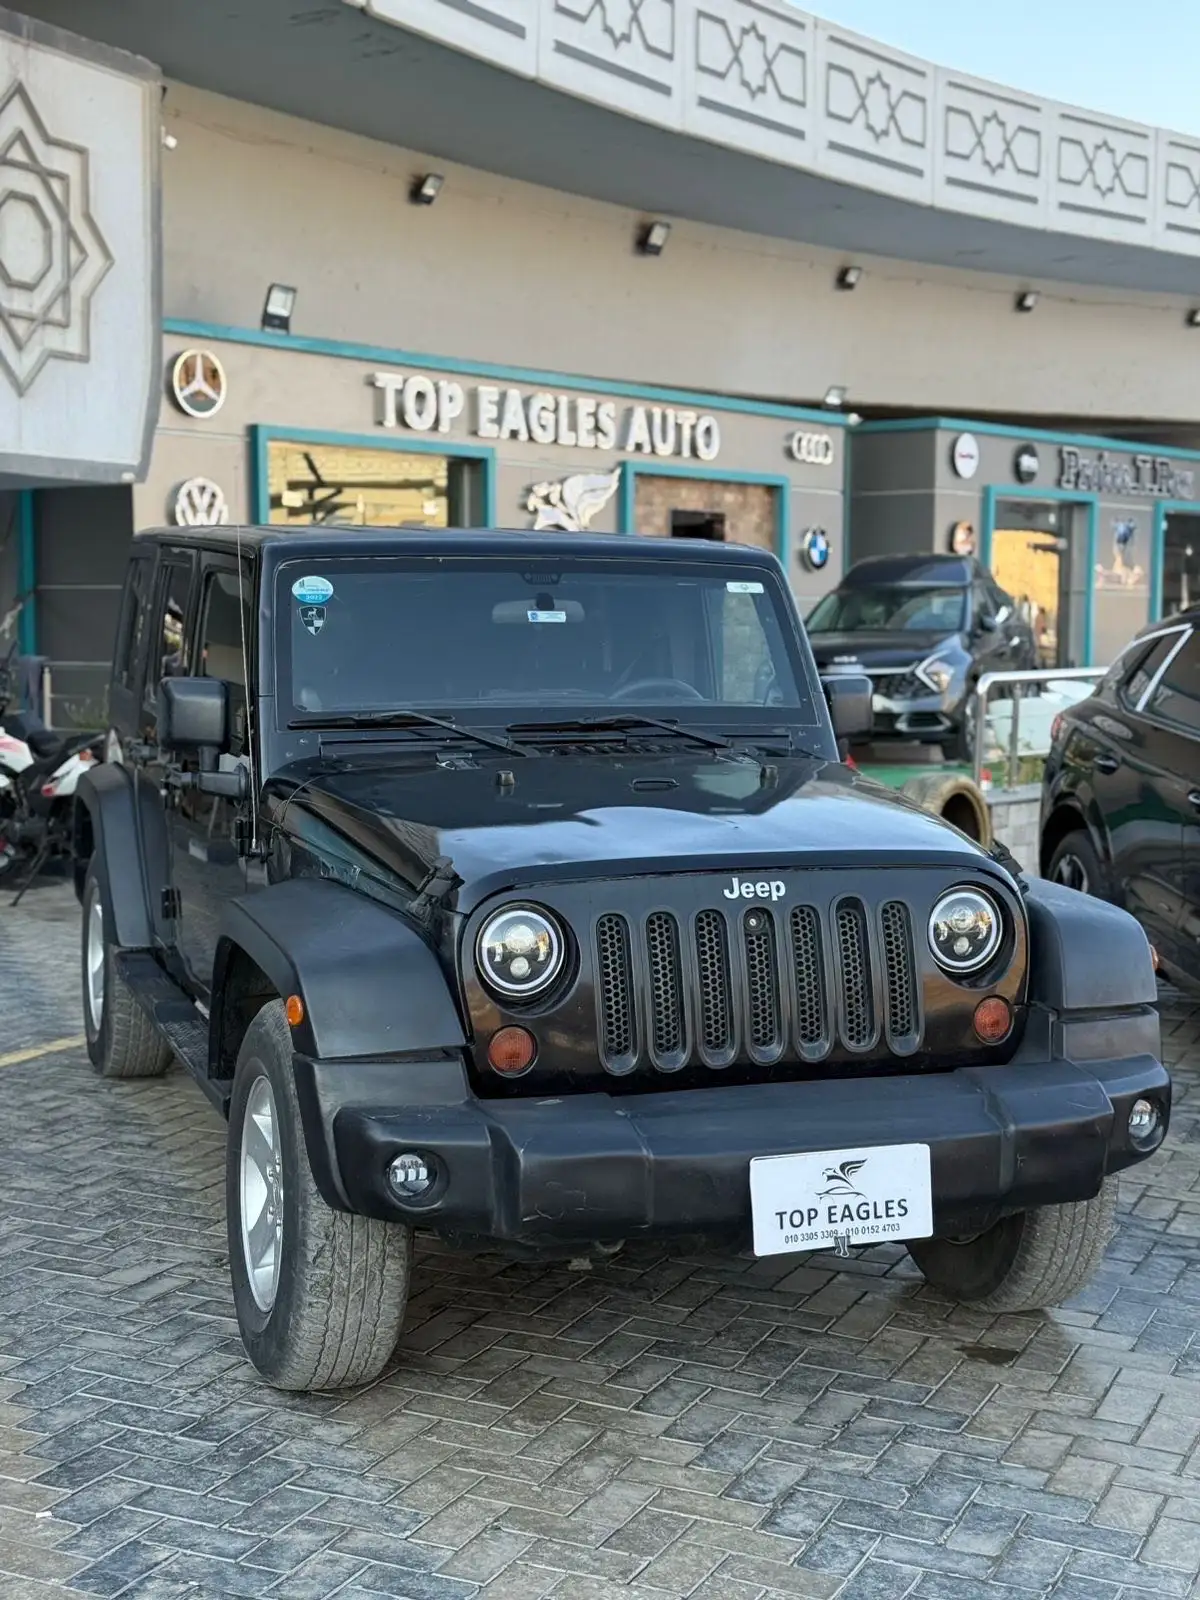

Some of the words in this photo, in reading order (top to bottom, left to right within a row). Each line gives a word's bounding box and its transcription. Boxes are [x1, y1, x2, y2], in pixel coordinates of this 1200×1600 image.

[374, 371, 464, 433] TOP
[476, 385, 617, 450] EAGLES
[625, 406, 721, 461] AUTO
[723, 877, 786, 901] Jeep
[775, 1207, 819, 1230] TOP
[827, 1198, 909, 1224] EAGLES
[784, 1234, 799, 1244] 010
[800, 1231, 819, 1241] 3305
[820, 1229, 839, 1240] 3309
[845, 1227, 859, 1237] 010
[861, 1225, 880, 1235] 0152
[882, 1222, 901, 1232] 4703
